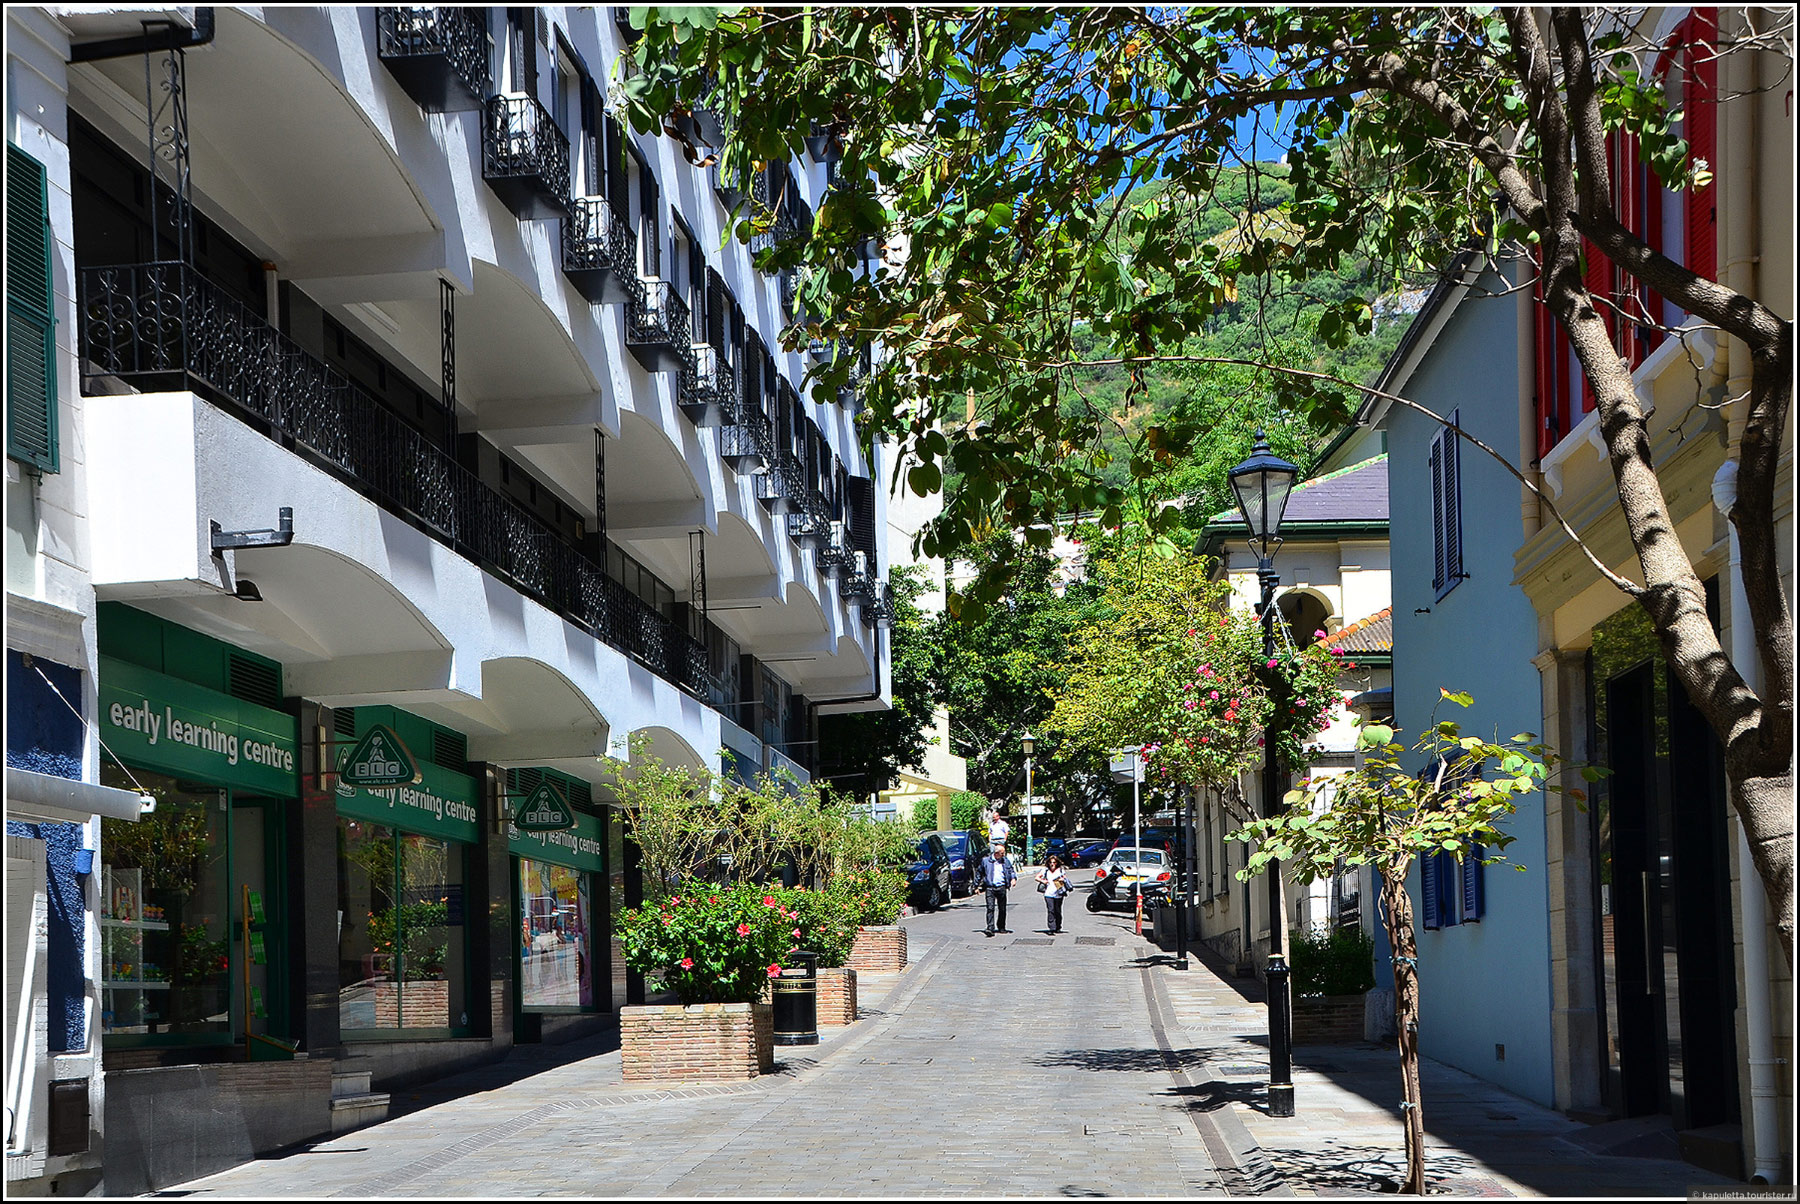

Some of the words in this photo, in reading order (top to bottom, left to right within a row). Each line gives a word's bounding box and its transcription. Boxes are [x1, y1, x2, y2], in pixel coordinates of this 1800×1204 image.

[110, 699, 160, 744] early
[165, 706, 238, 766] learning
[244, 739, 293, 770] centre
[357, 763, 398, 775] ELC
[399, 787, 443, 821] learning
[445, 800, 476, 822] centre
[527, 813, 561, 822] ELC
[548, 830, 578, 855] learning
[579, 838, 600, 855] centre
